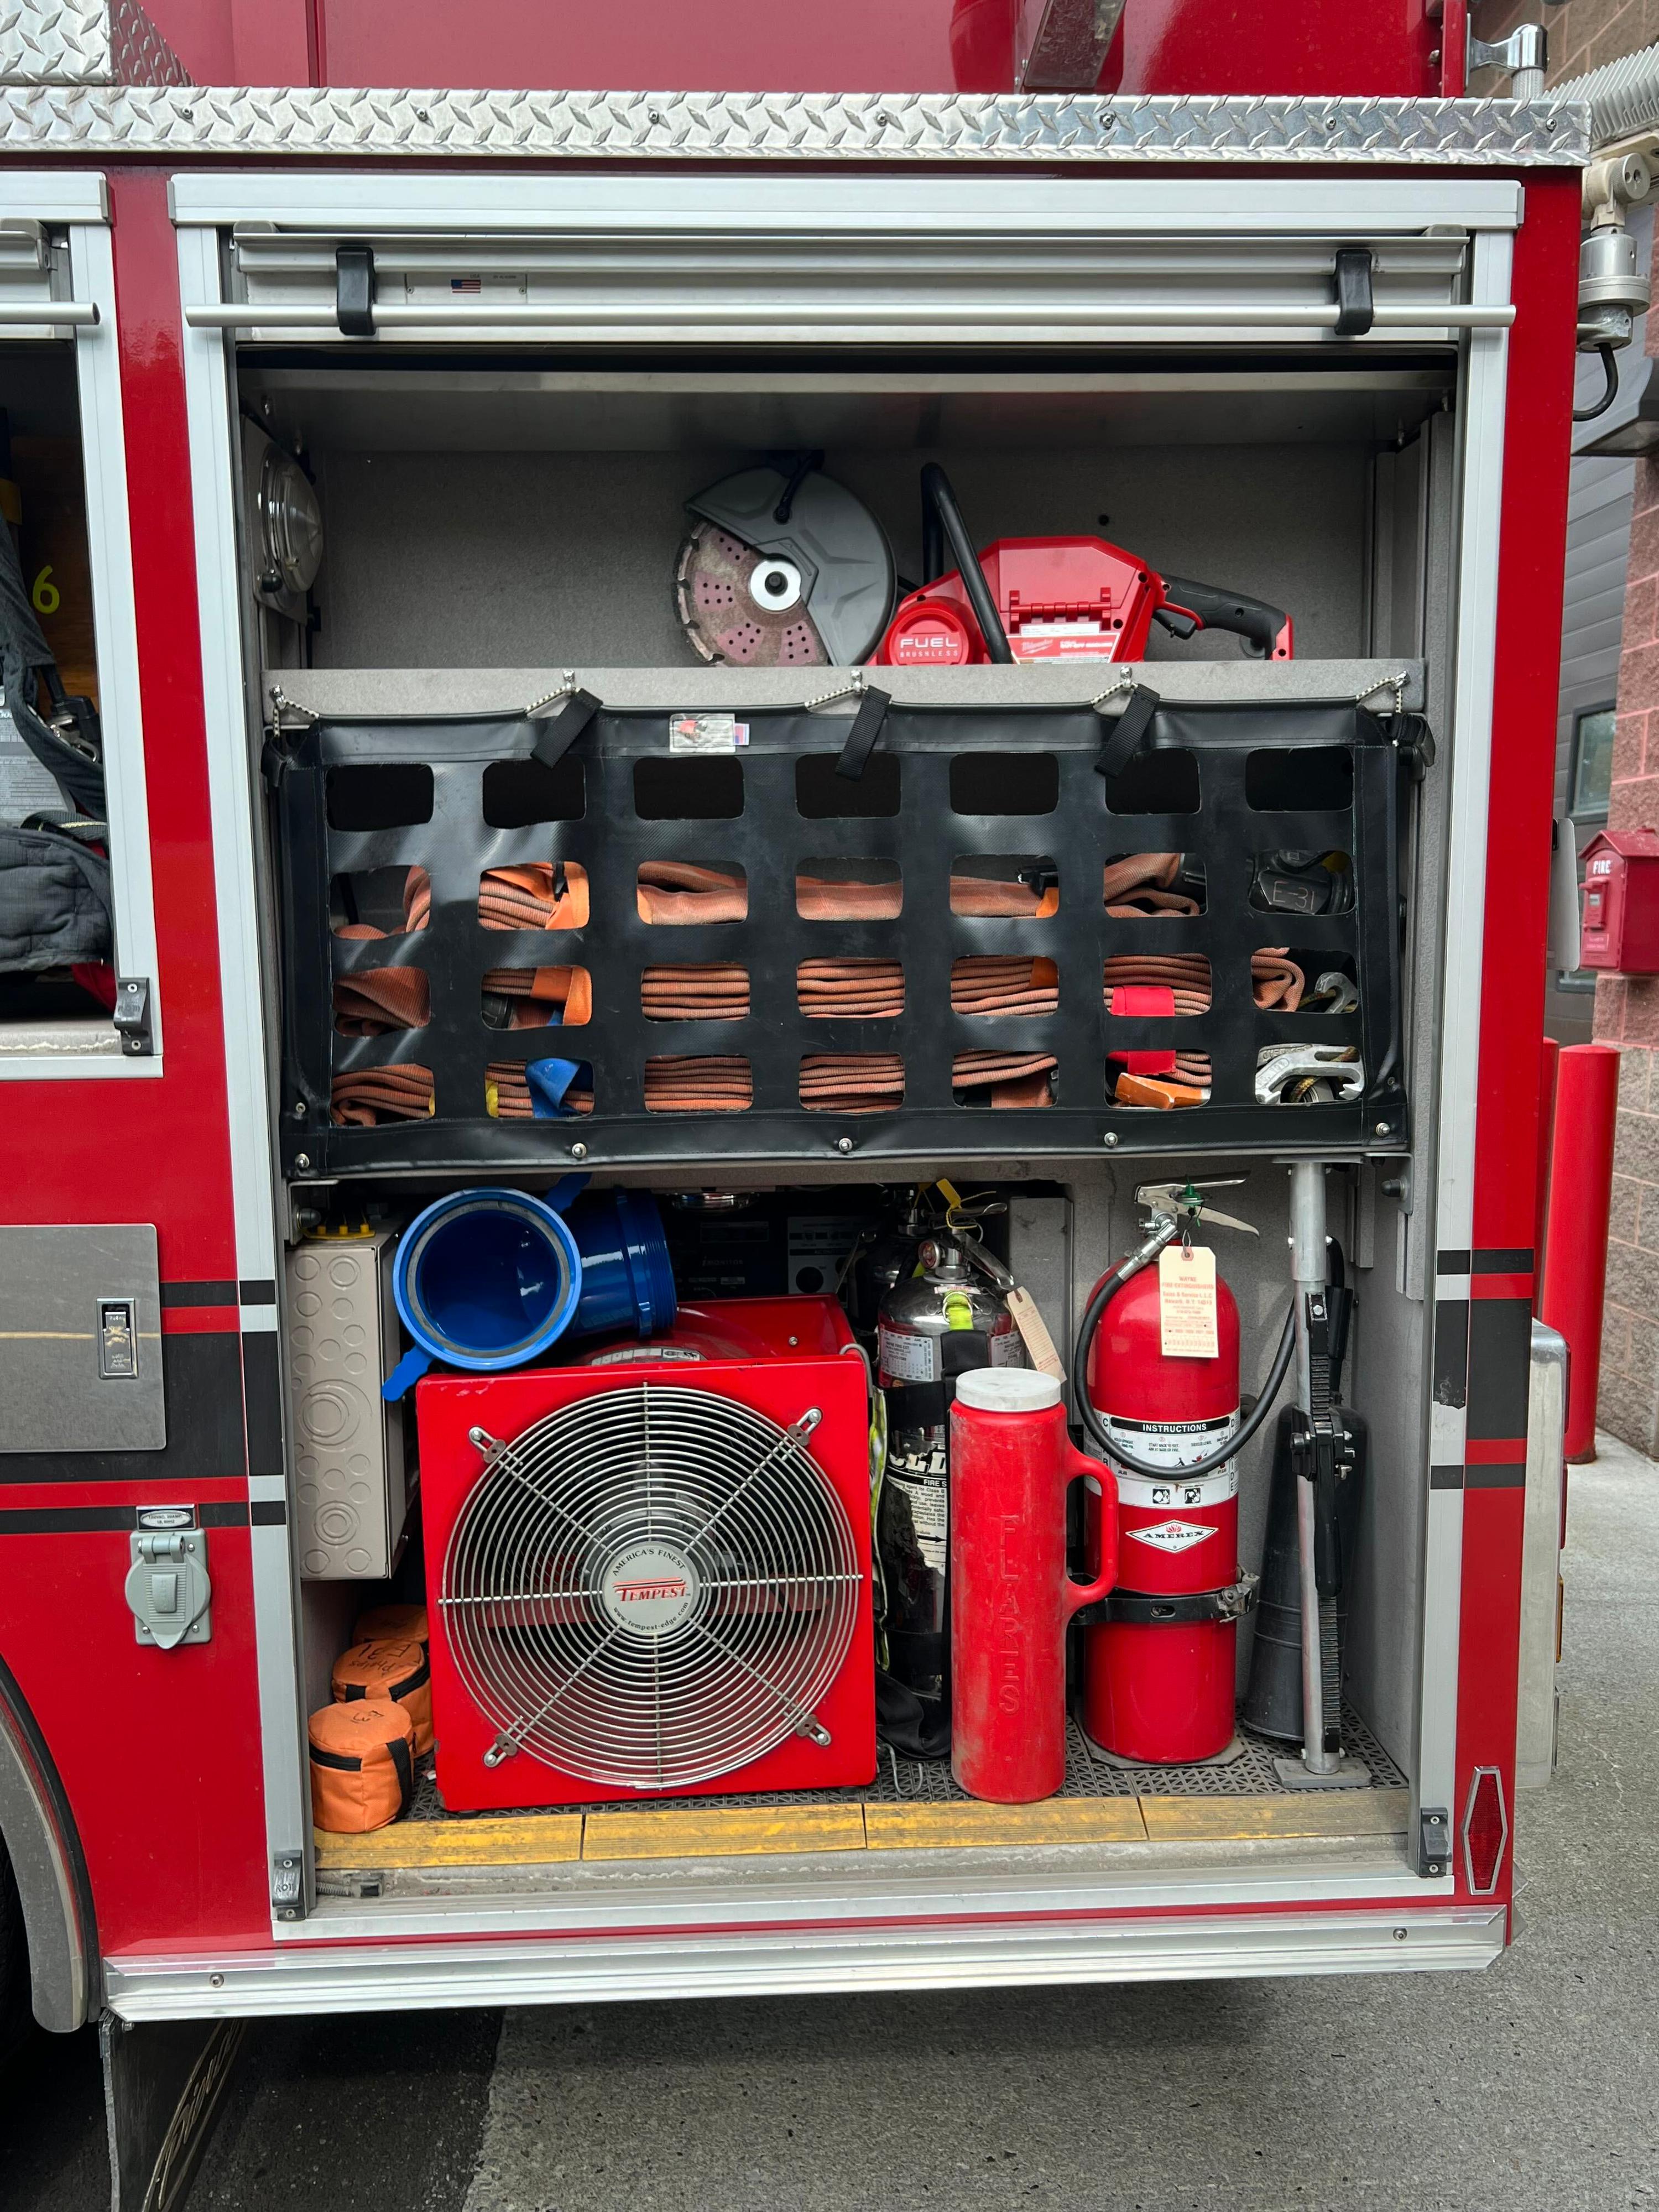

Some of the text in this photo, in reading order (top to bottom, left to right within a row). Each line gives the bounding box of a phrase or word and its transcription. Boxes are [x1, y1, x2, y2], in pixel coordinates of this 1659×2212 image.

[33, 565, 60, 615] 6
[900, 637, 958, 649] FUEL
[1593, 859, 1611, 875] FIRE
[1272, 880, 1315, 911] E-31
[1142, 1423, 1207, 1433] INSTRUCTIONS
[923, 1479, 941, 1487] FIRE
[1143, 1530, 1205, 1538] AMEREX
[612, 1548, 686, 1576] AMERICA'S FINEST
[615, 1584, 688, 1602] TEMPEST
[613, 1601, 689, 1631] www.tempest-edge.com
[999, 1515, 1021, 1715] FLARES
[358, 1644, 411, 1660] E31
